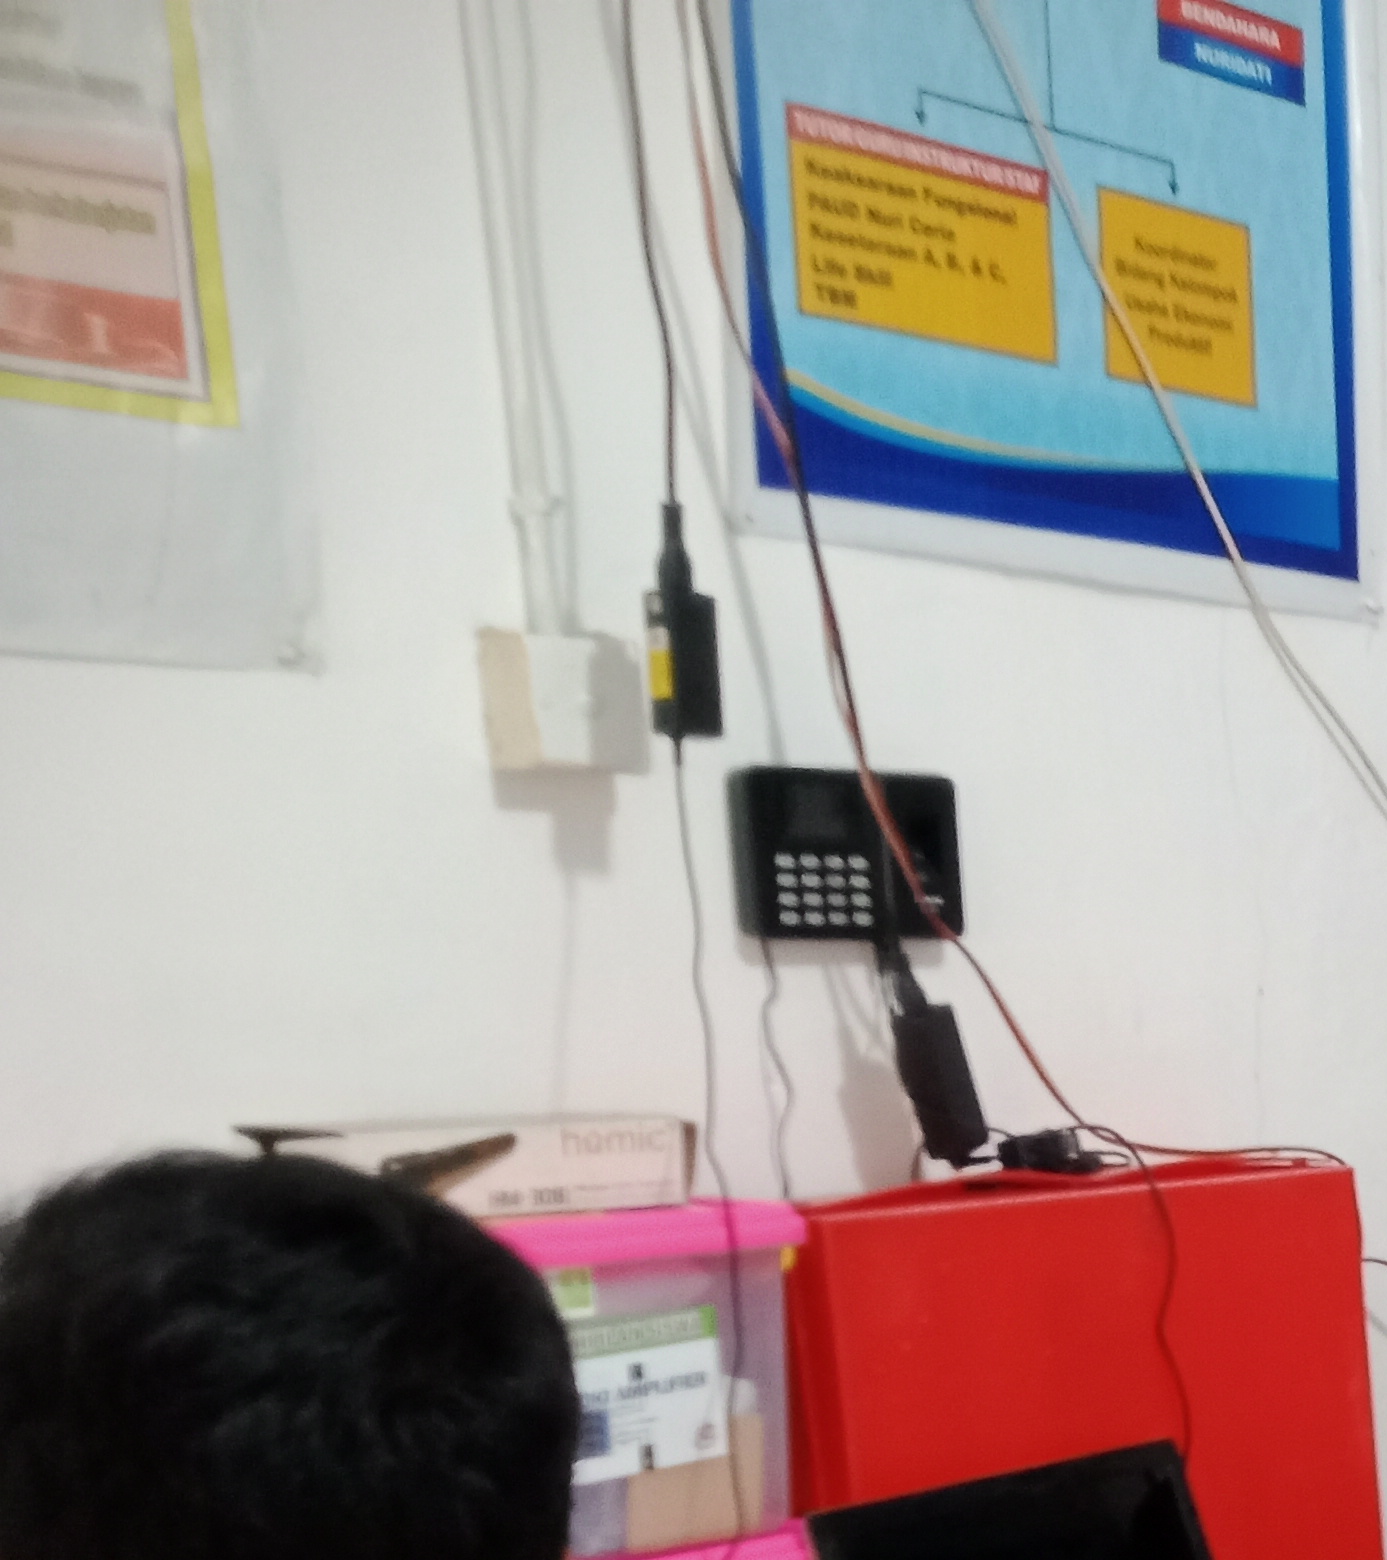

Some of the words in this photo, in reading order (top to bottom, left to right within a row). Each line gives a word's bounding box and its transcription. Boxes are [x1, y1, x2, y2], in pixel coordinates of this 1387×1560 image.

[808, 192, 860, 219] PAUD
[922, 186, 1018, 226] Fungsional
[811, 254, 848, 278] Life
